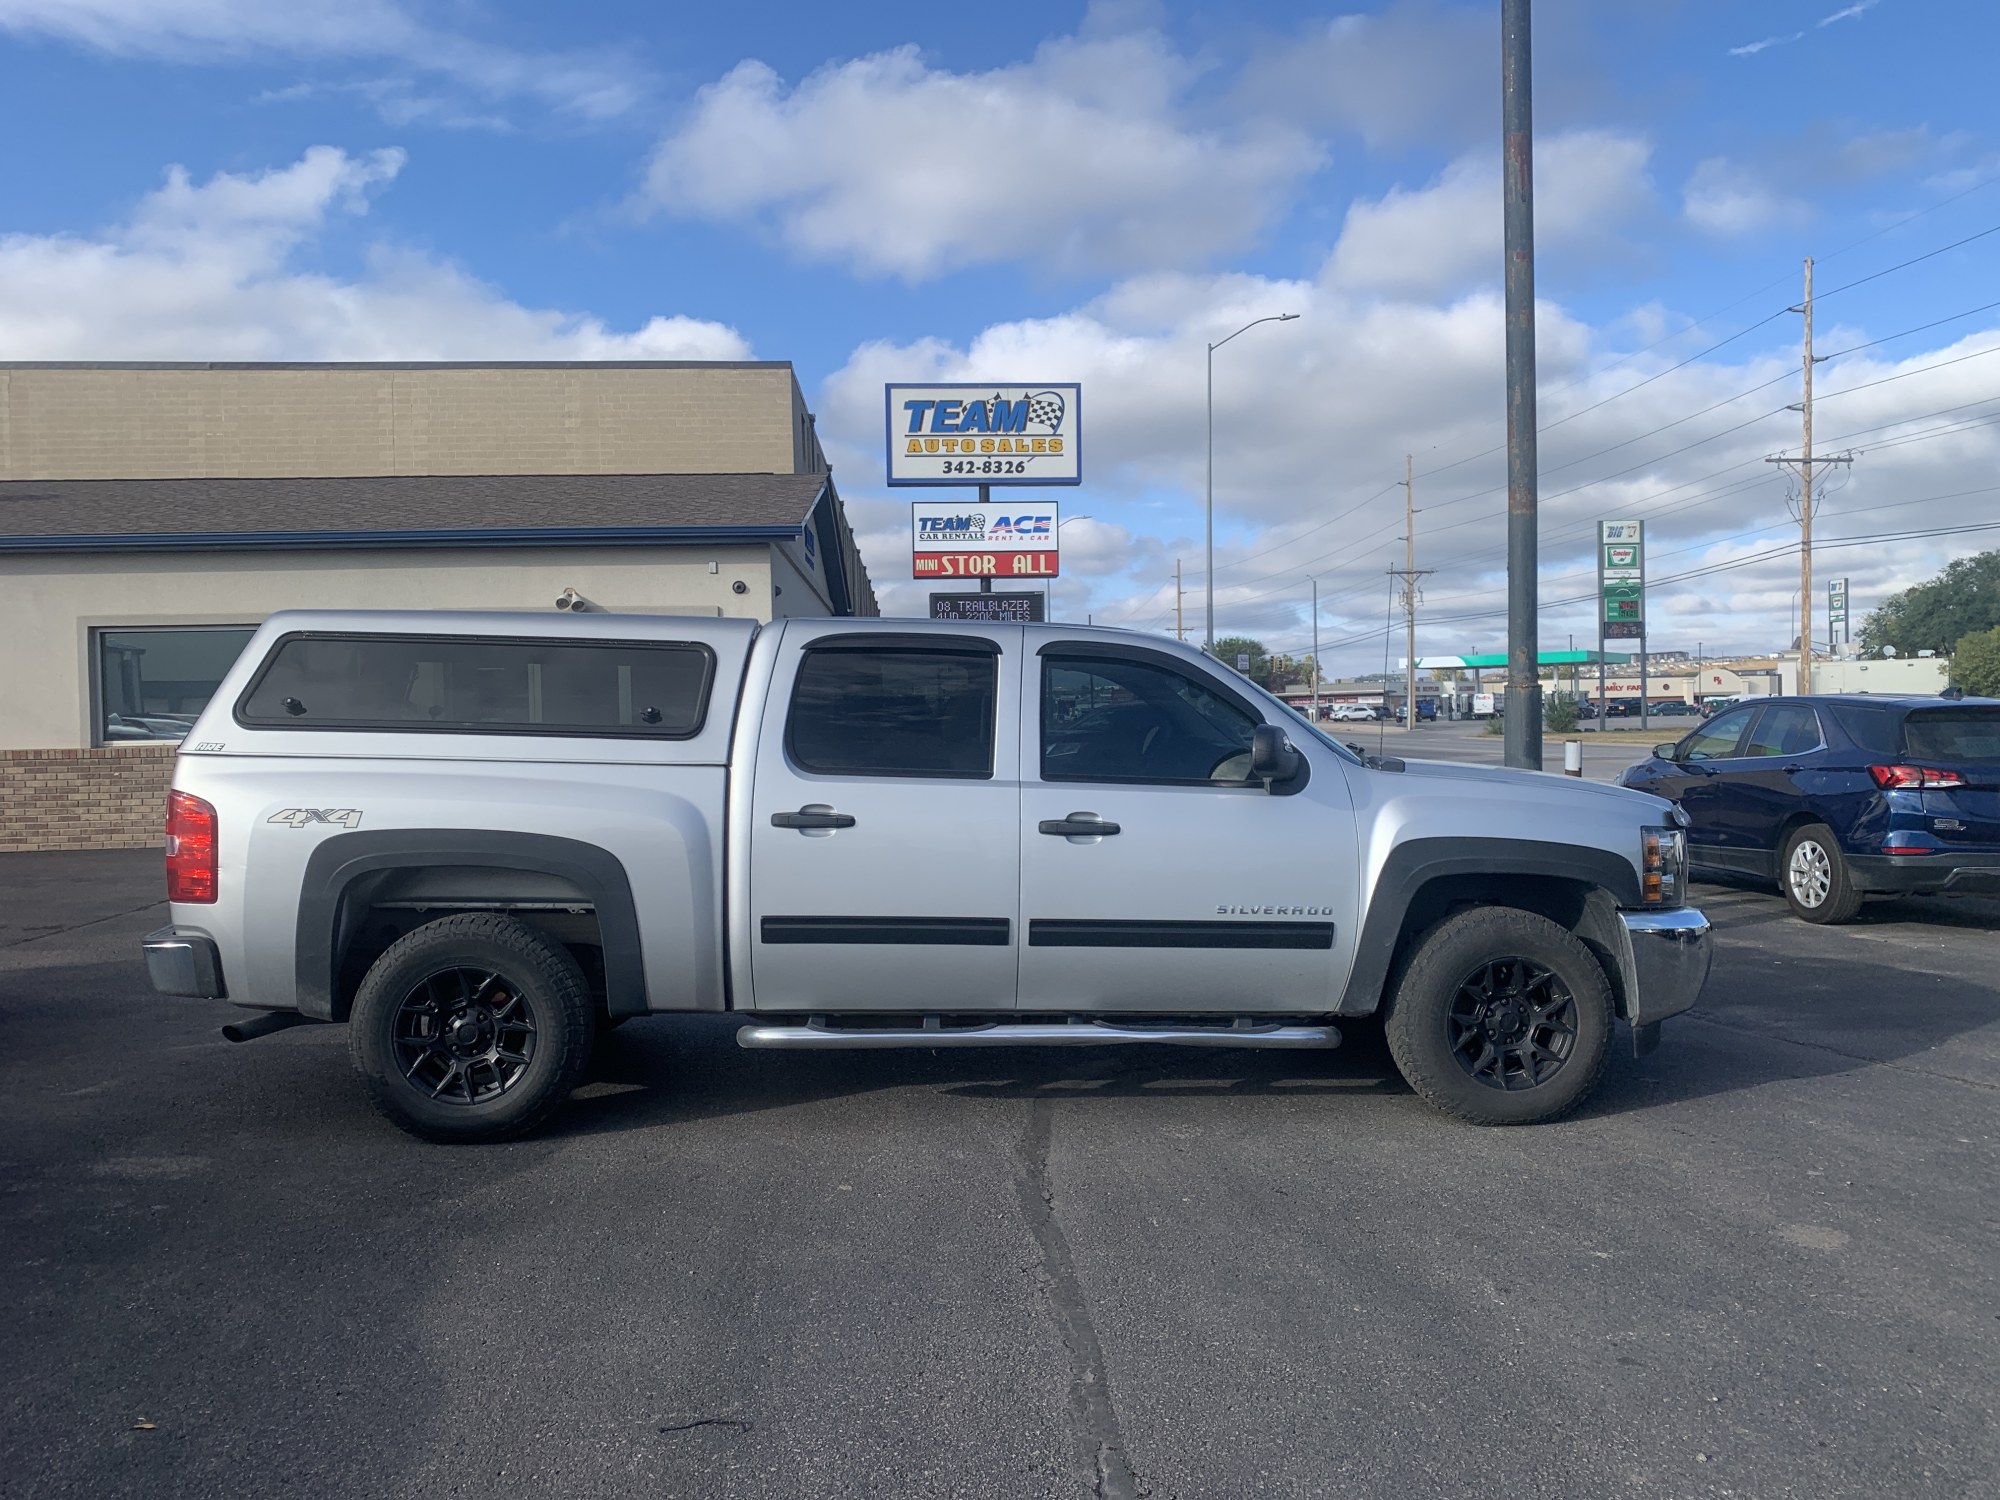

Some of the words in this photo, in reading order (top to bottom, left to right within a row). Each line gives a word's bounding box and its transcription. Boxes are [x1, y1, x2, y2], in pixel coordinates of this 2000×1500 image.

[903, 399, 1032, 433] TEAM
[942, 460, 1025, 474] 342-8326
[918, 516, 972, 531] TEAM
[989, 516, 1052, 534] ACE
[1607, 525, 1624, 538] BIG
[916, 559, 938, 571] MINI
[941, 555, 997, 575] STOR
[1012, 554, 1053, 574] ALL
[937, 601, 951, 612] 08
[957, 600, 1031, 612] TRAILBLAZER
[966, 612, 993, 621] 220K
[999, 611, 1031, 622] MILES
[1216, 904, 1333, 916] SILVERADO
